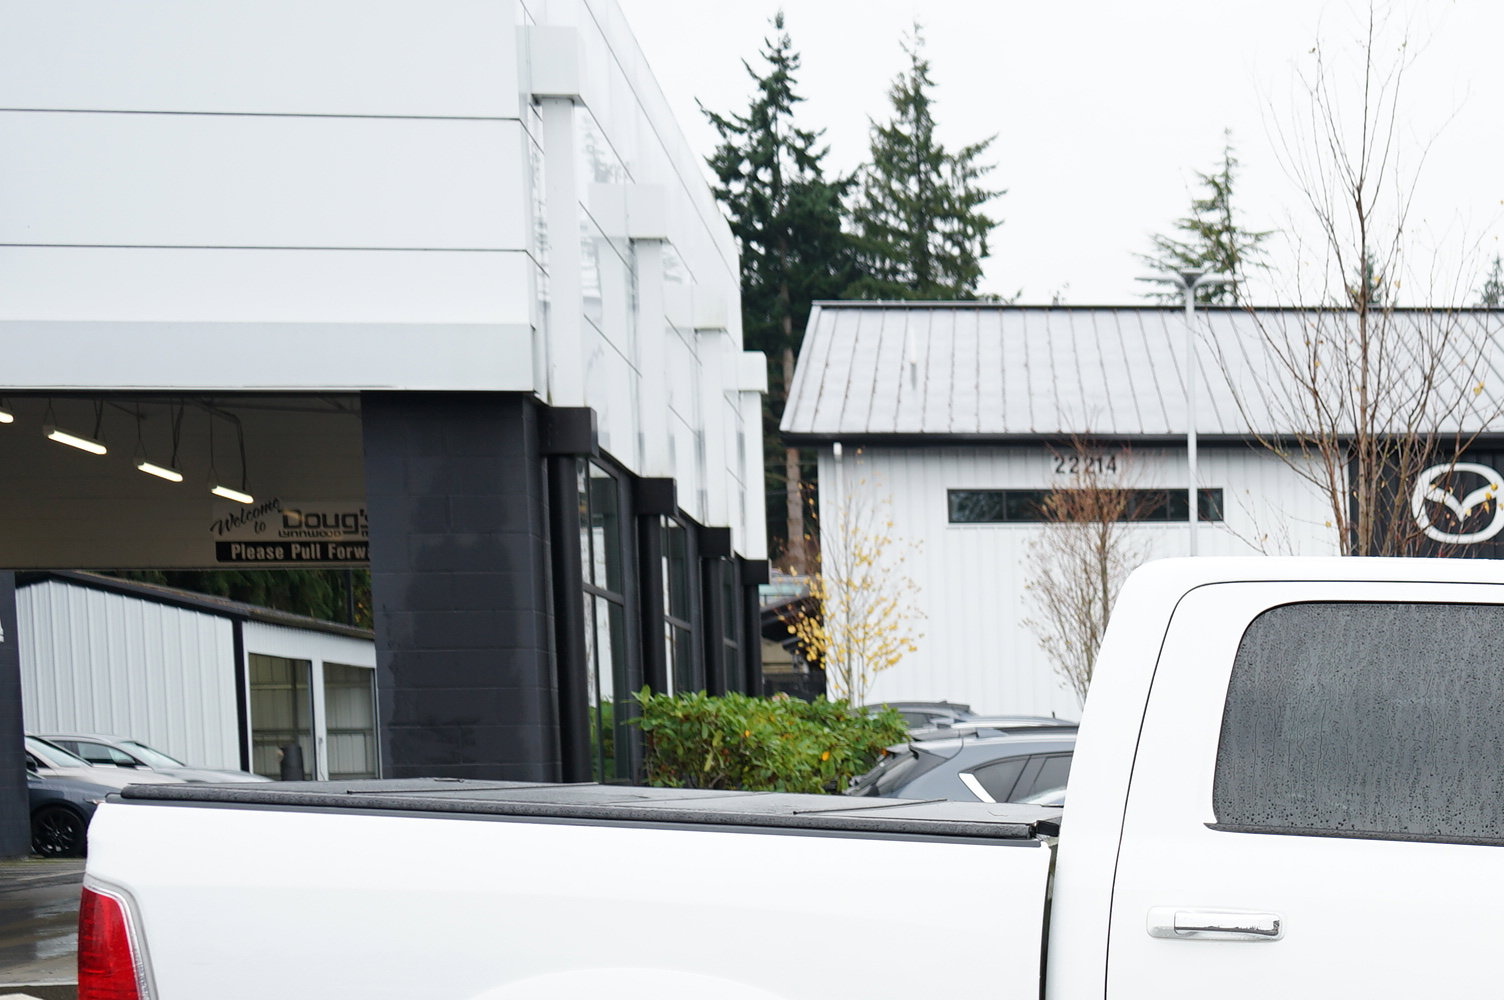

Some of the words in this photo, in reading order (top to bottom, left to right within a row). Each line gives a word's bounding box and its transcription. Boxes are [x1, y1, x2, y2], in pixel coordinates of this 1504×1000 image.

[1054, 456, 1117, 474] 22214
[209, 497, 281, 536] Welcome
[254, 521, 266, 534] to
[231, 543, 284, 560] Please
[291, 543, 321, 560] Pull
[328, 543, 368, 560] Forw
